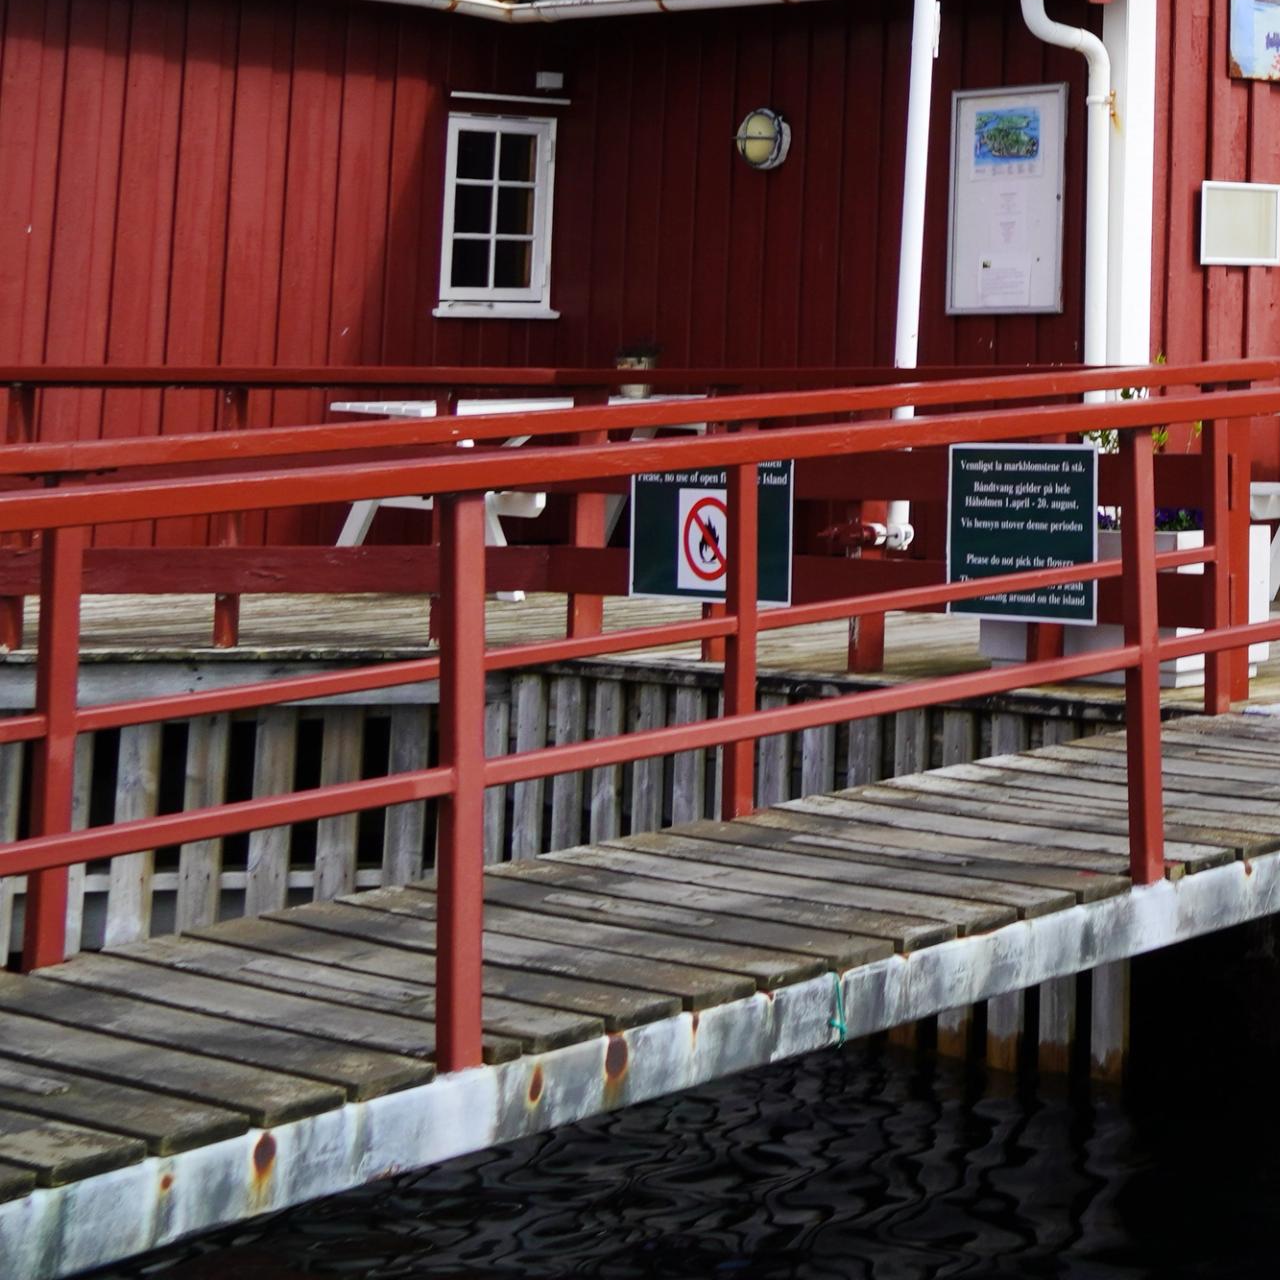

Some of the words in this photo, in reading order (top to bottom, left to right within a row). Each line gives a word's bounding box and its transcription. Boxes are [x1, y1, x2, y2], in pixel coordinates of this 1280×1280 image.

[961, 460, 994, 473] Vennligst
[996, 460, 1002, 470] la
[1004, 461, 1060, 472] markblomstene
[1062, 461, 1069, 472] få
[665, 474, 674, 482] no
[676, 474, 688, 483] use
[690, 471, 699, 483] of
[700, 473, 718, 486] open
[763, 473, 787, 485] Island
[974, 481, 1013, 494] Båndtvang
[1015, 483, 1041, 495] gjelder
[1043, 484, 1053, 496] på
[1055, 483, 1070, 494] hele
[965, 496, 1002, 507] Håholmen
[961, 517, 972, 527] Vis
[974, 518, 999, 530] hensyn
[1001, 520, 1025, 529] utover
[1026, 519, 1048, 530] denne
[1051, 520, 1083, 532] perioden
[967, 554, 988, 565] Please
[991, 555, 1000, 565] do
[1002, 555, 1013, 565] not
[1016, 556, 1031, 568] pick
[1034, 556, 1044, 567] the
[1009, 593, 1035, 603] around
[1037, 595, 1047, 603] on
[1049, 594, 1060, 604] the
[1063, 595, 1085, 606] island
